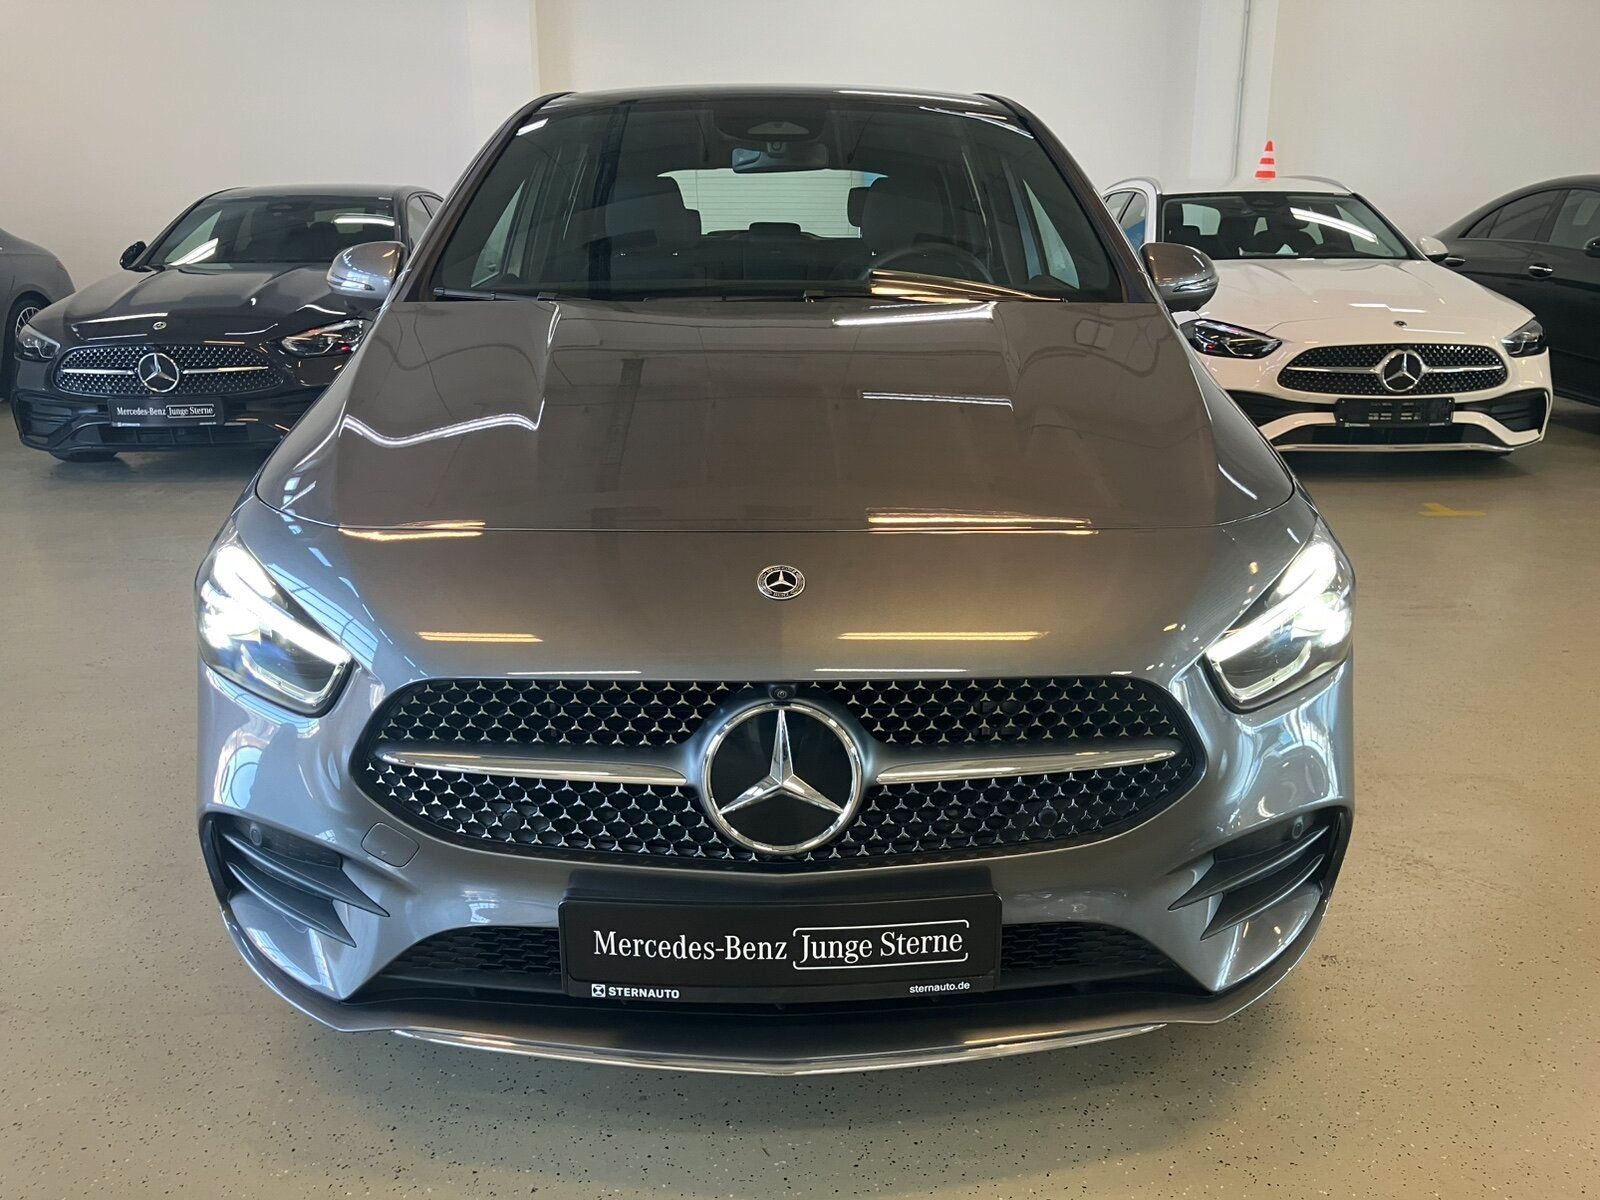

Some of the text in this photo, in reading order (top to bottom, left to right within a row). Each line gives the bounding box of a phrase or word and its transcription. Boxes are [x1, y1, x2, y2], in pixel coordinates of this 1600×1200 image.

[116, 406, 213, 416] Mercedes-Benz Junge Sterne
[593, 930, 963, 964] Mercedes-Benz Junge Sterne
[608, 986, 680, 999] STERNAUTO
[909, 981, 970, 994] sternauto.de
